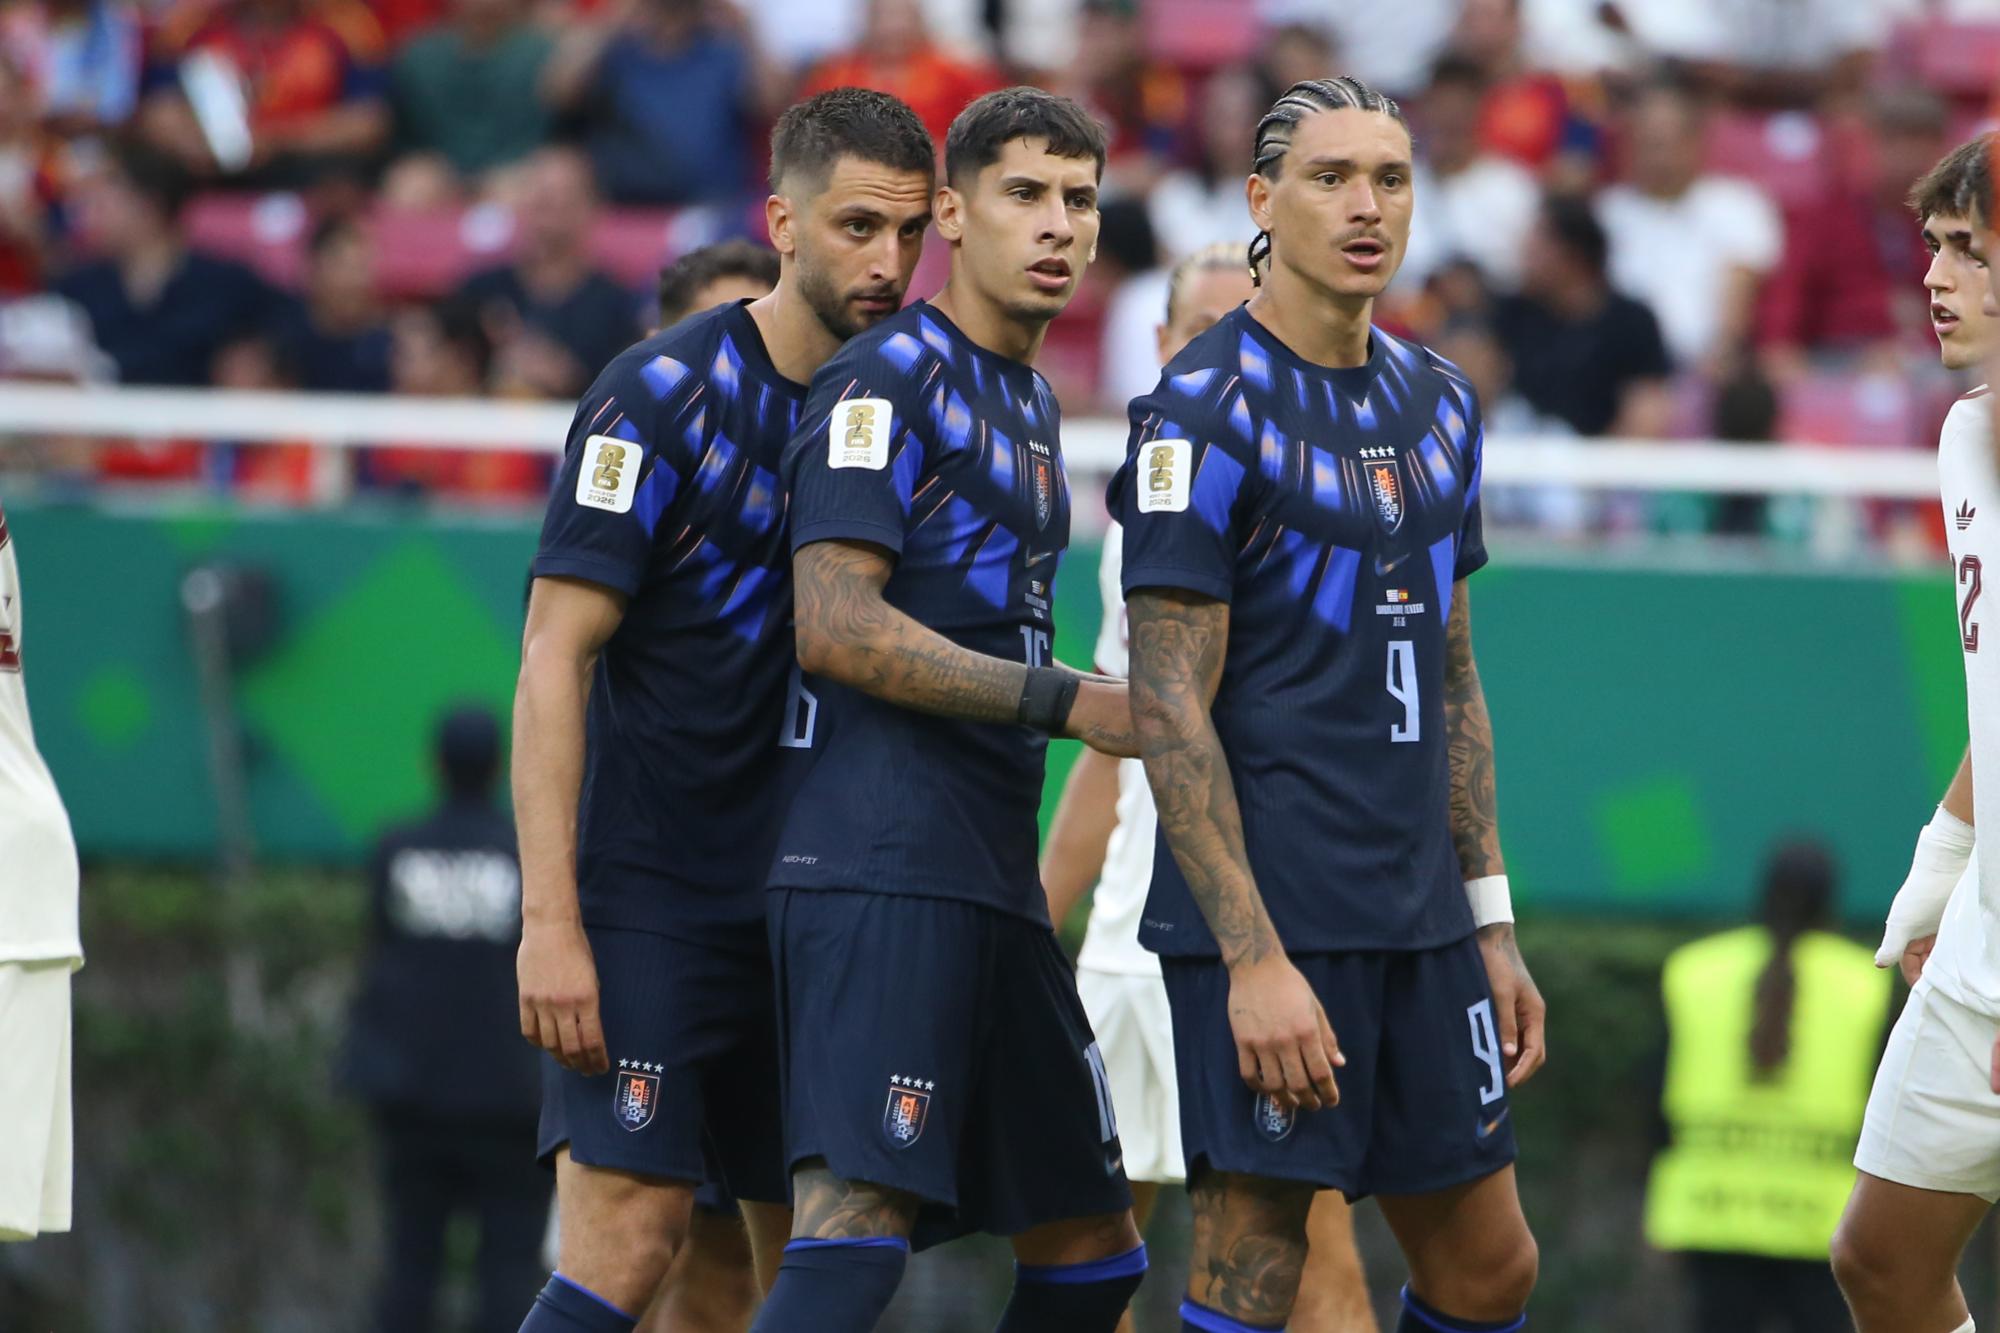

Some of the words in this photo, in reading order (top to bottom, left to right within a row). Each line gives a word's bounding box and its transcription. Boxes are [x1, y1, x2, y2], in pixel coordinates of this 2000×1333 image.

[587, 494, 616, 506] 2026
[843, 454, 871, 463] 2026
[1951, 553, 1982, 654] 2
[1386, 640, 1420, 742] 9
[1467, 998, 1504, 1106] 9
